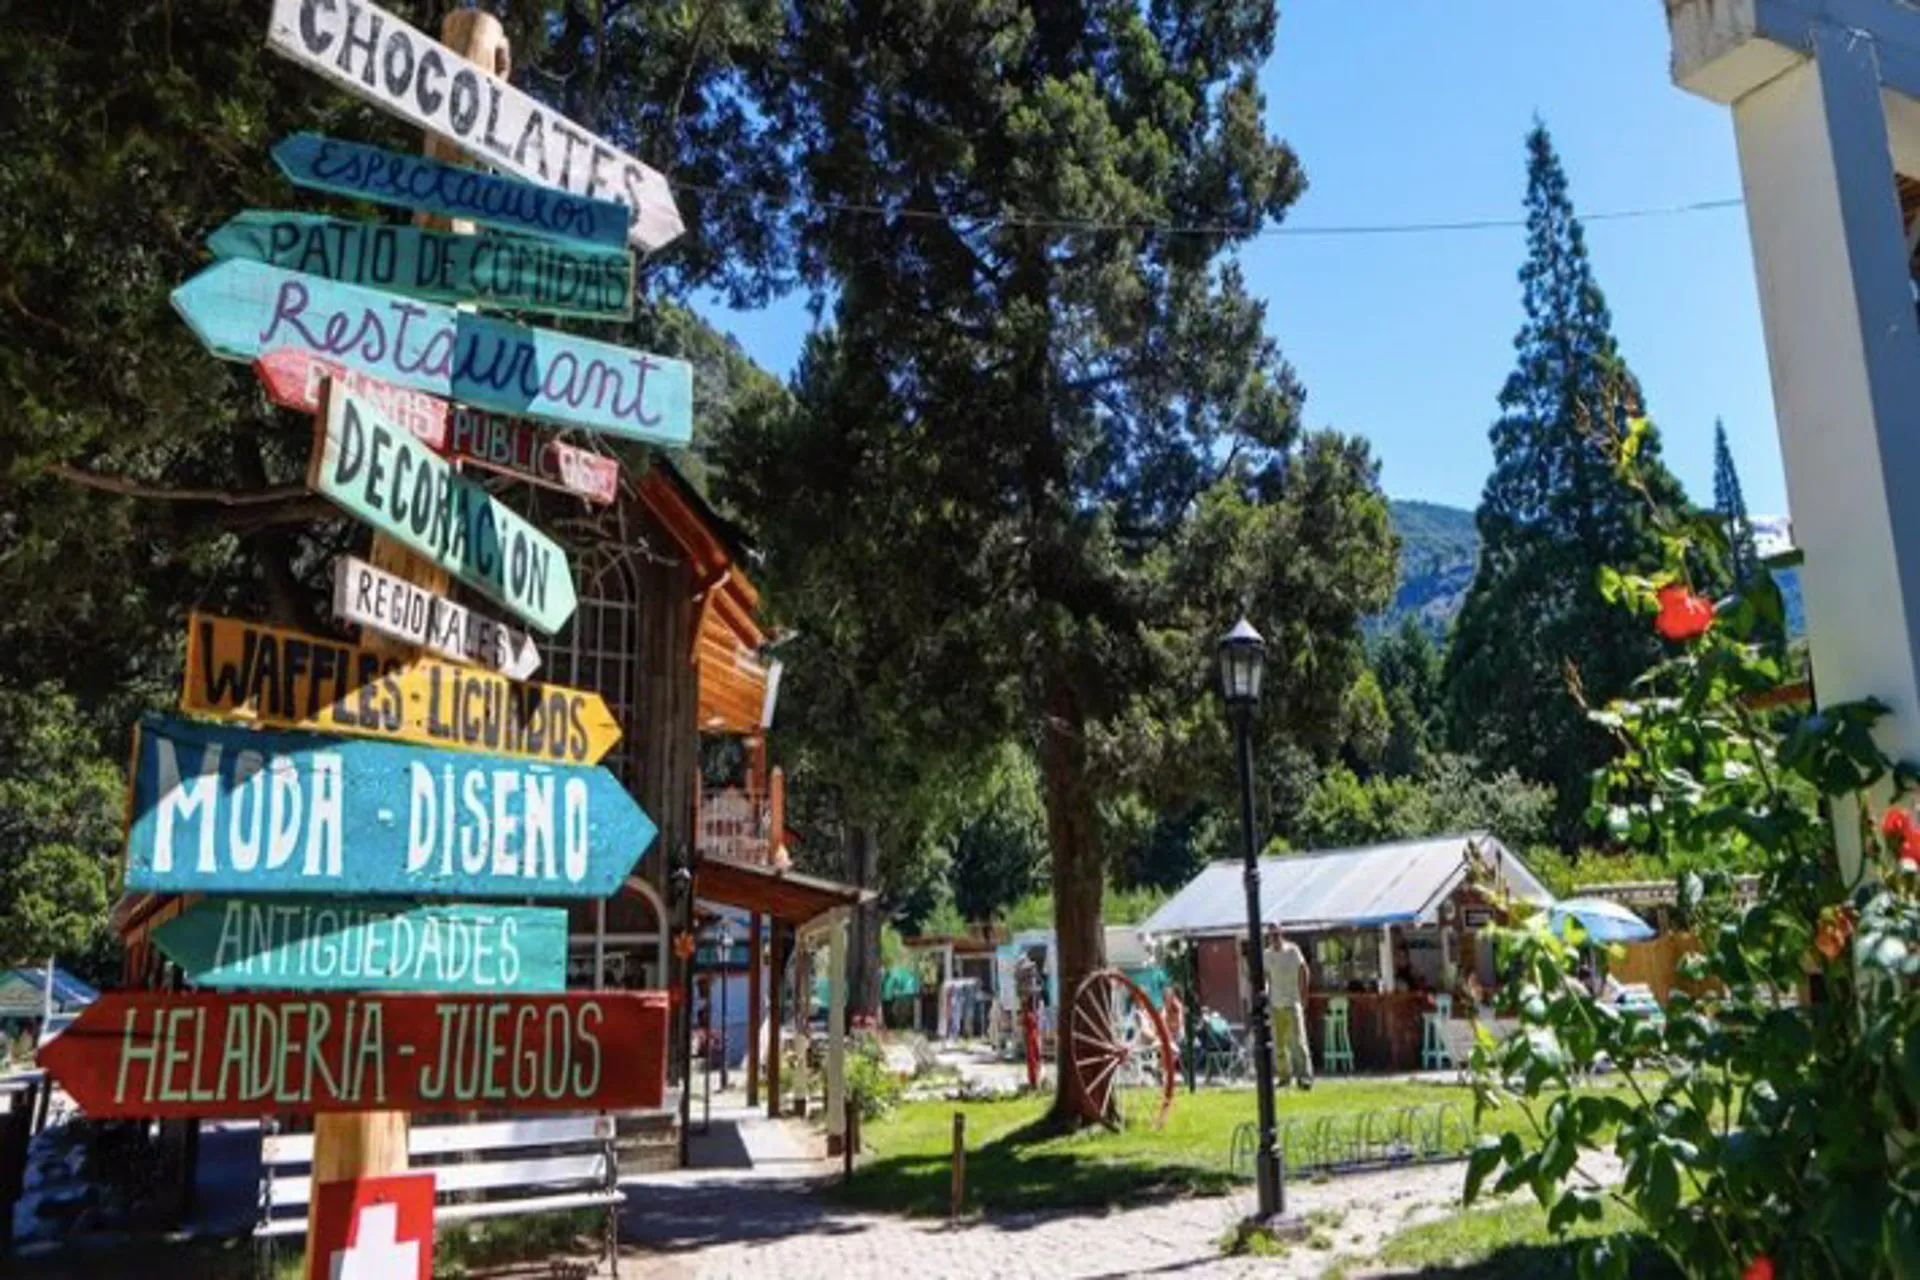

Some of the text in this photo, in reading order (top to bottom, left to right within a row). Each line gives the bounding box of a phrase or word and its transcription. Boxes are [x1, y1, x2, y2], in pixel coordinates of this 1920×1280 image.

[299, 0, 644, 228] CHOCOLATES
[268, 222, 627, 312] PATIO DE COMIDAS
[260, 280, 662, 427] Restaurant
[357, 568, 508, 669] REGIONALES
[203, 622, 403, 733] WAFFLES
[150, 738, 342, 877] MODA
[419, 1002, 603, 1099] JUEGOS
